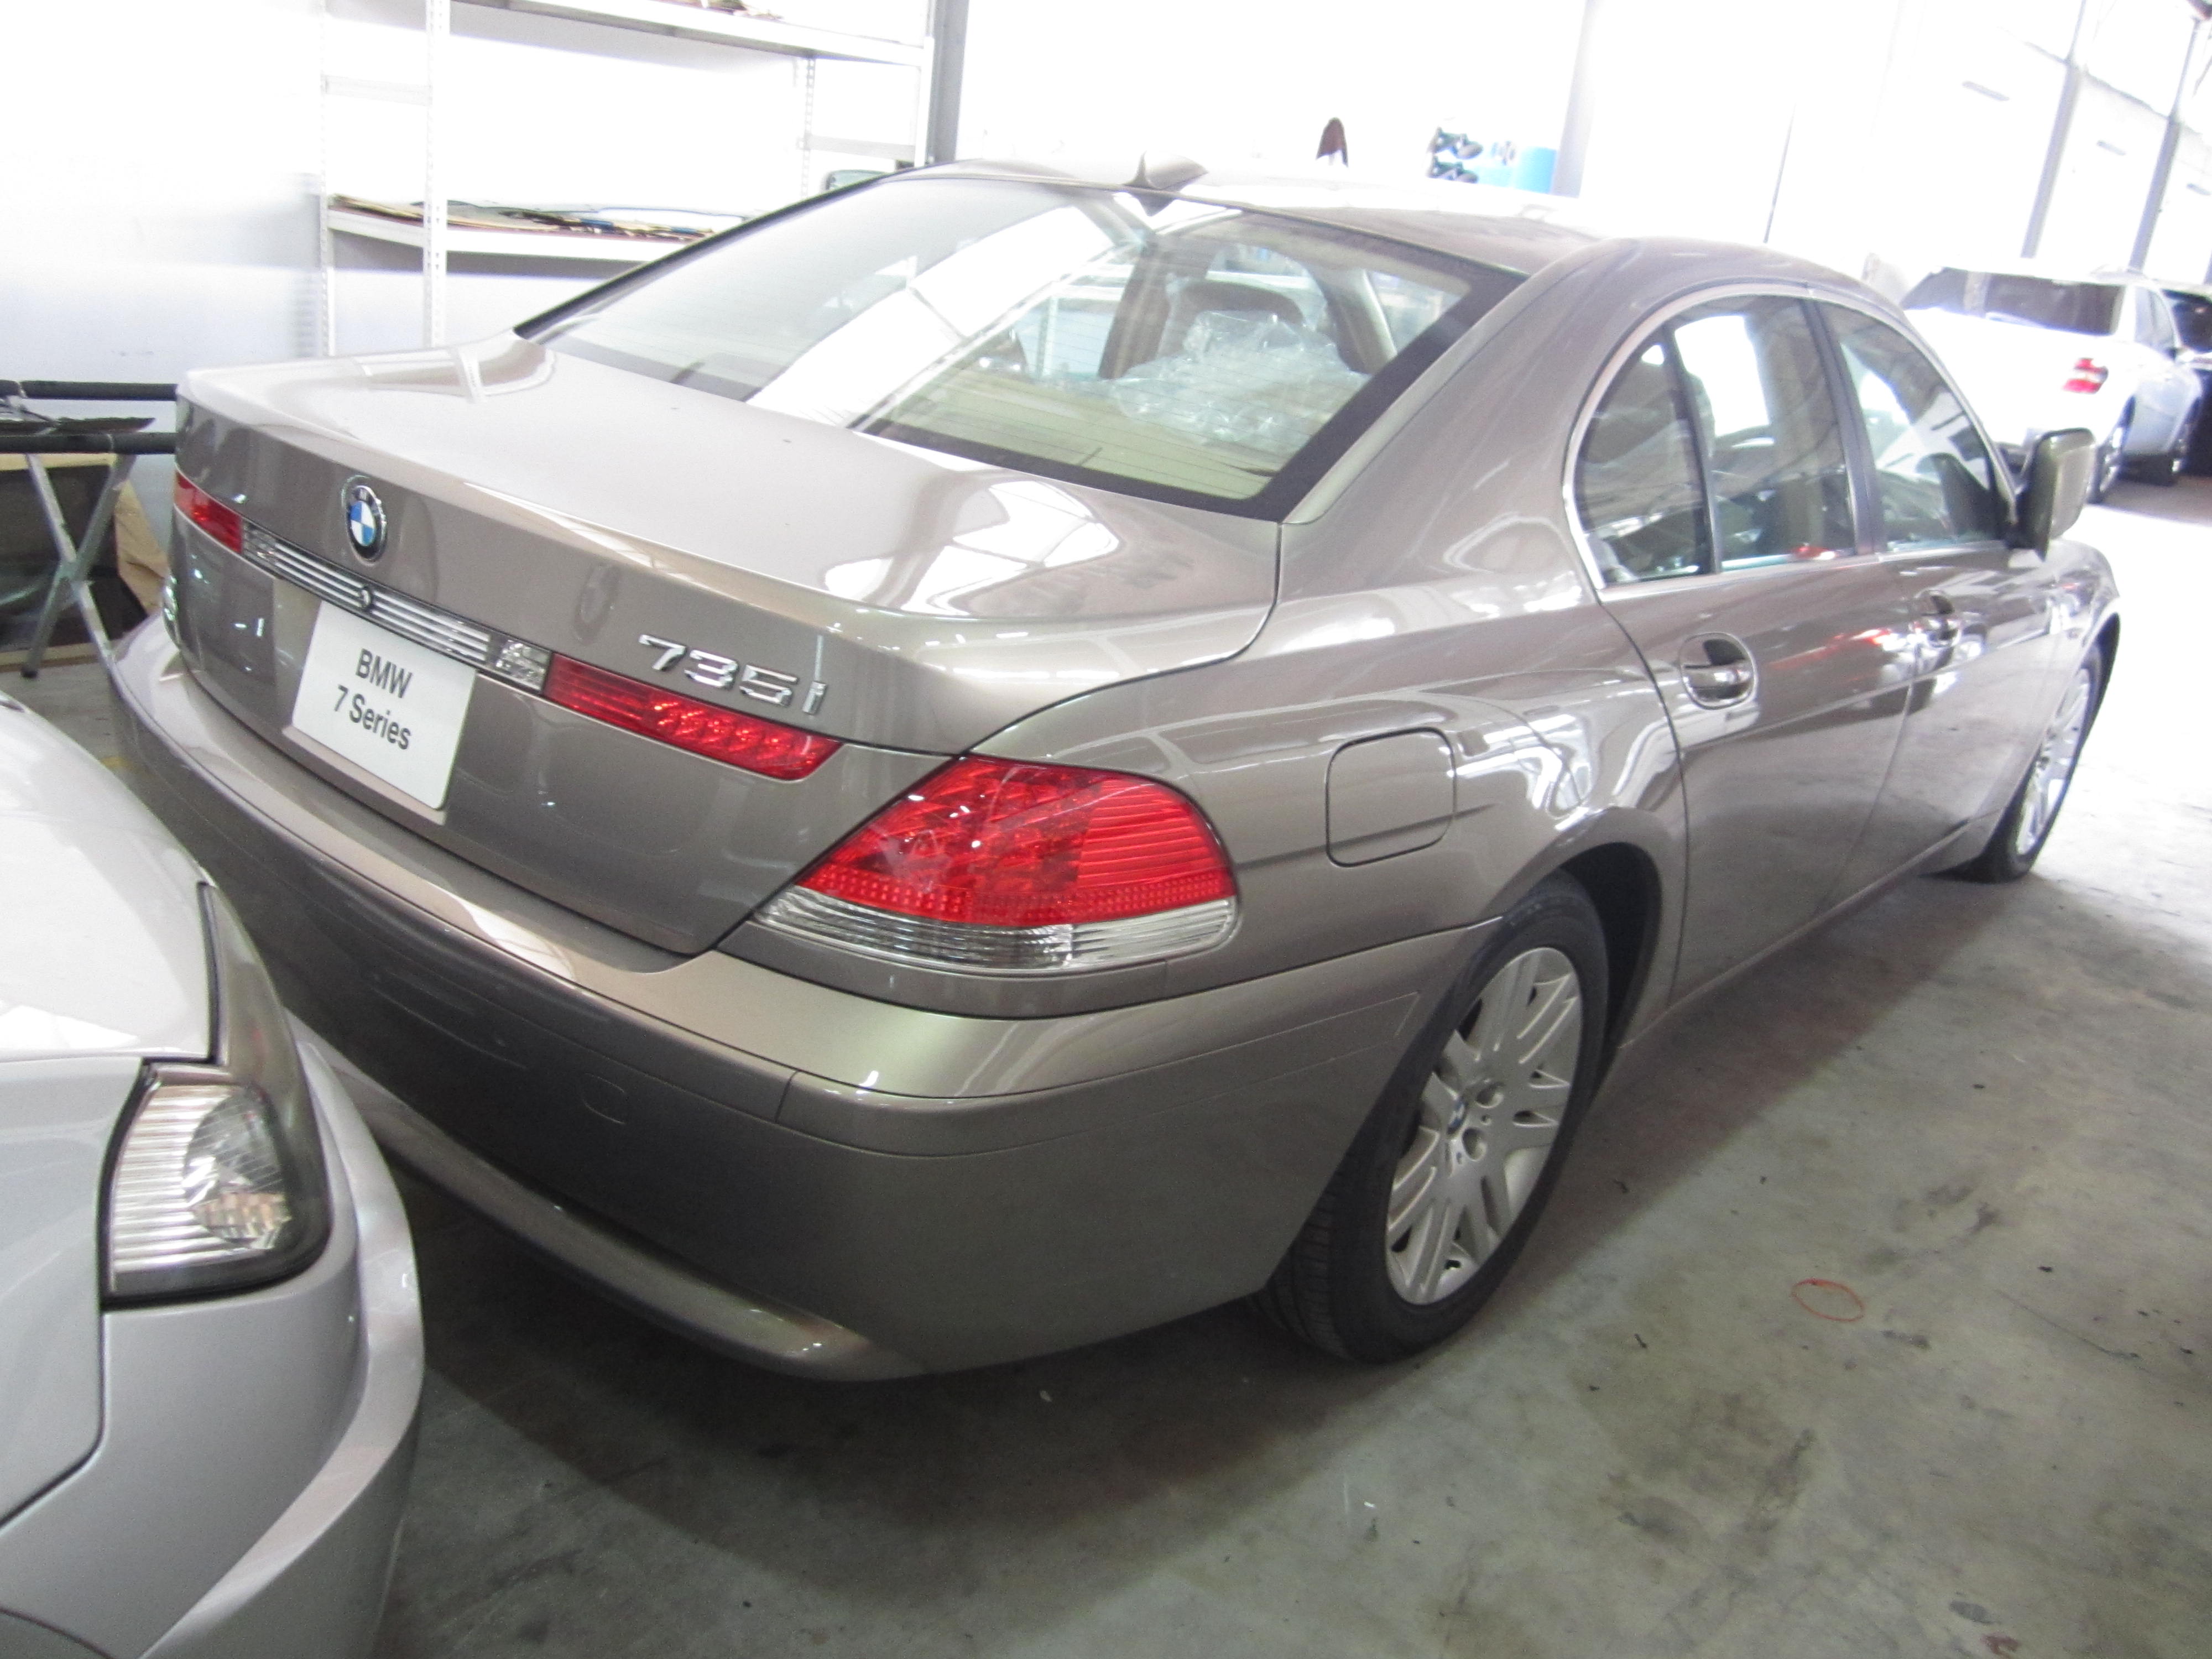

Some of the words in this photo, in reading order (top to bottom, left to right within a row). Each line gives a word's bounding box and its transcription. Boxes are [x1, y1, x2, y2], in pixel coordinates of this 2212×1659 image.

[355, 648, 413, 699] BMW
[638, 634, 827, 716] 735i
[333, 684, 349, 712] 7
[349, 693, 412, 750] Series
